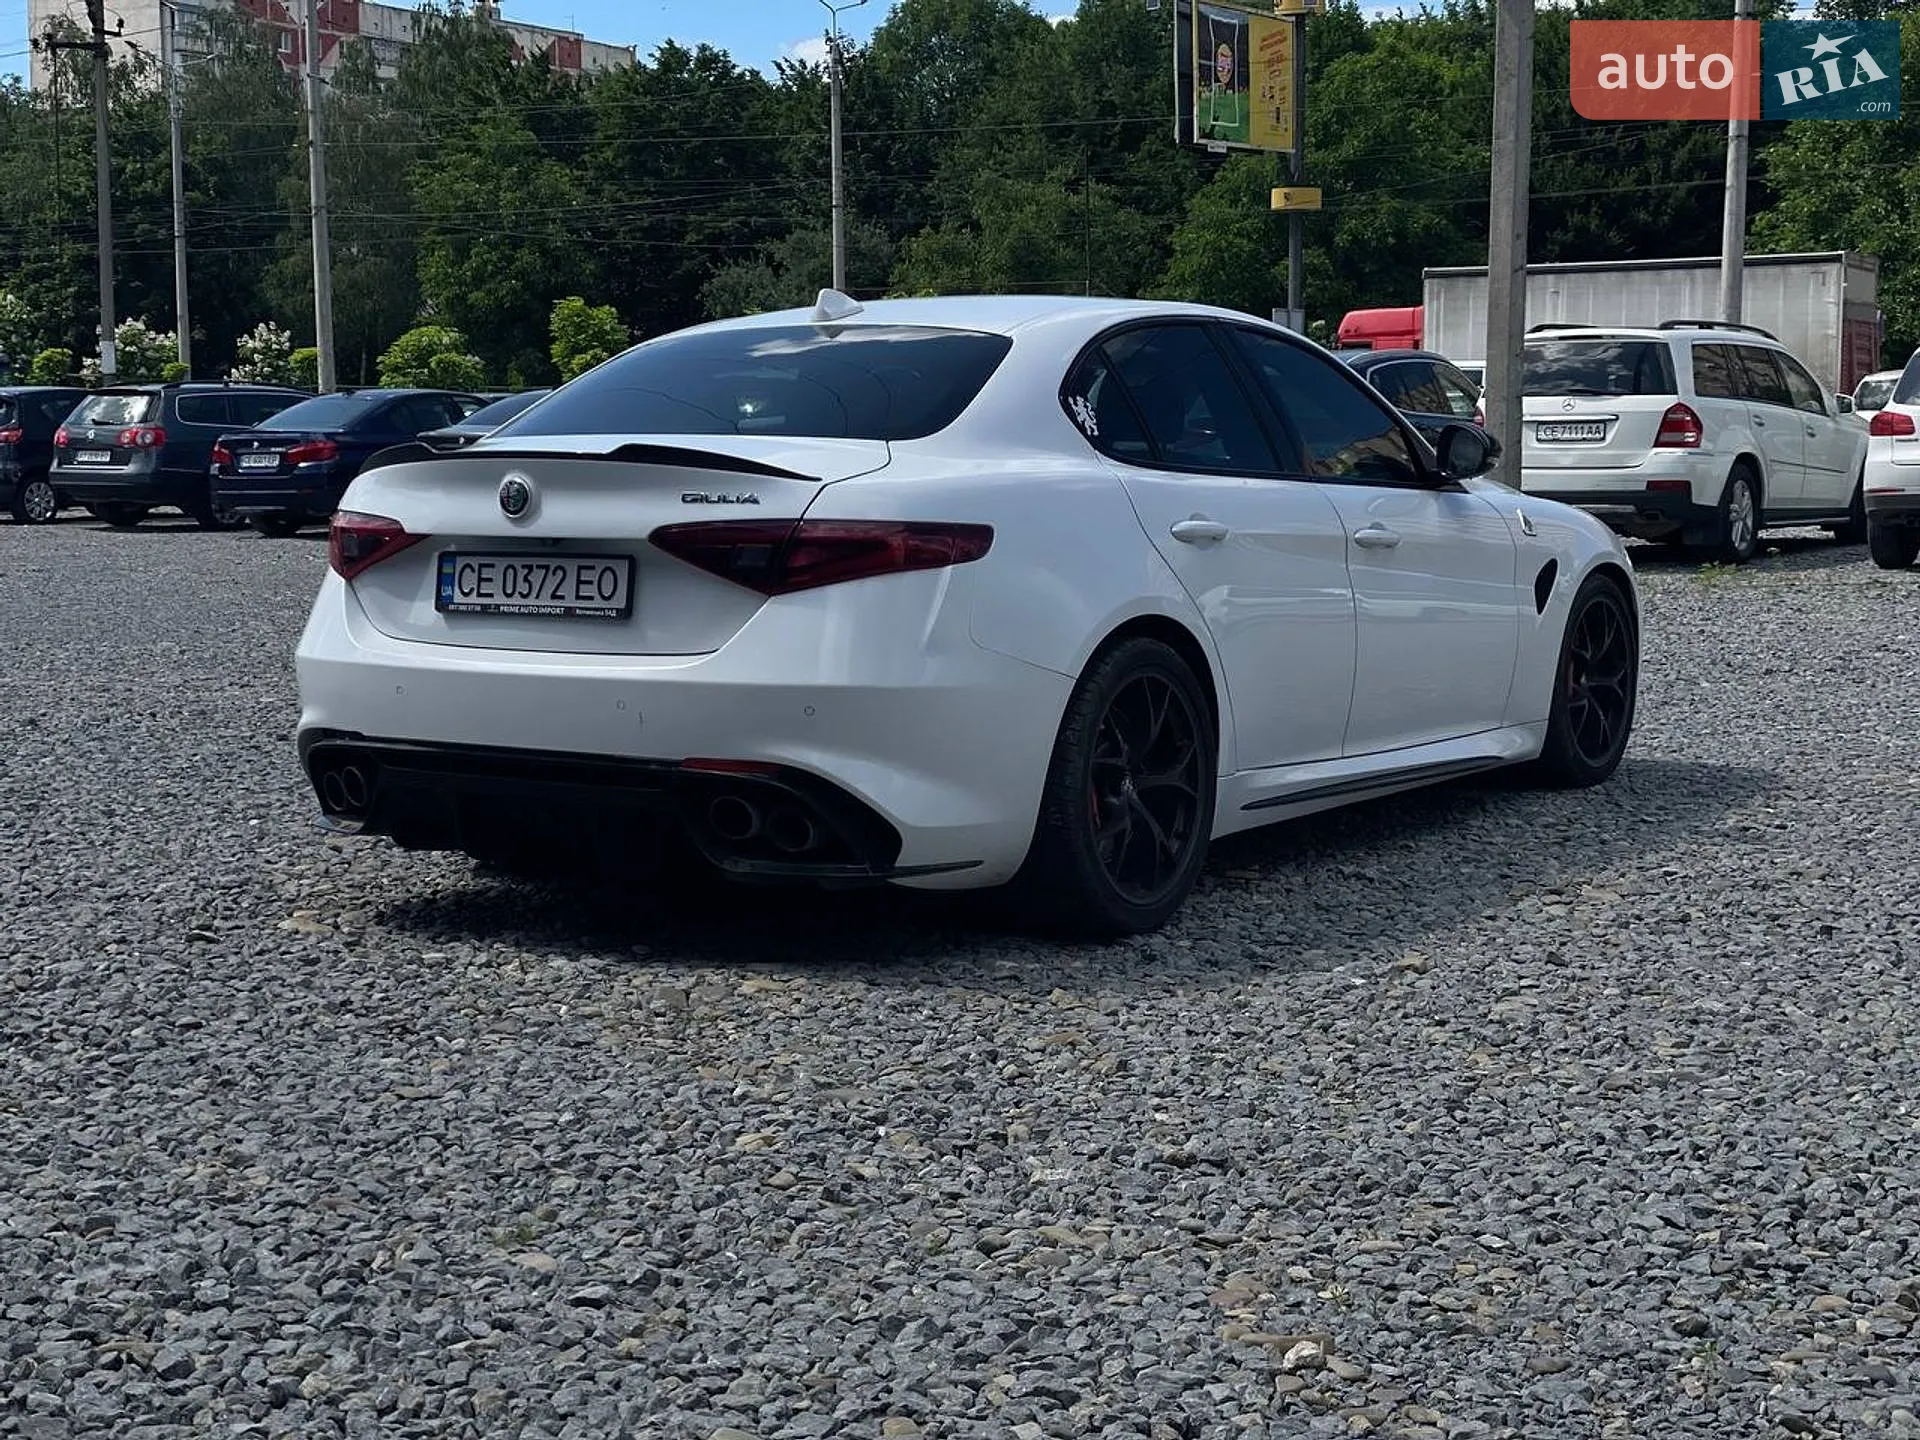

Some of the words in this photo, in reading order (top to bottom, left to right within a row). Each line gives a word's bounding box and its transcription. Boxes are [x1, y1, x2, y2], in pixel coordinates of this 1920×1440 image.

[681, 492, 761, 505] GIULIA
[457, 562, 496, 598] CE
[502, 563, 568, 601] 0372
[575, 564, 618, 602] EO
[500, 605, 520, 614] PRIME
[520, 606, 538, 614] AUTO
[538, 606, 565, 615] IMPORT
